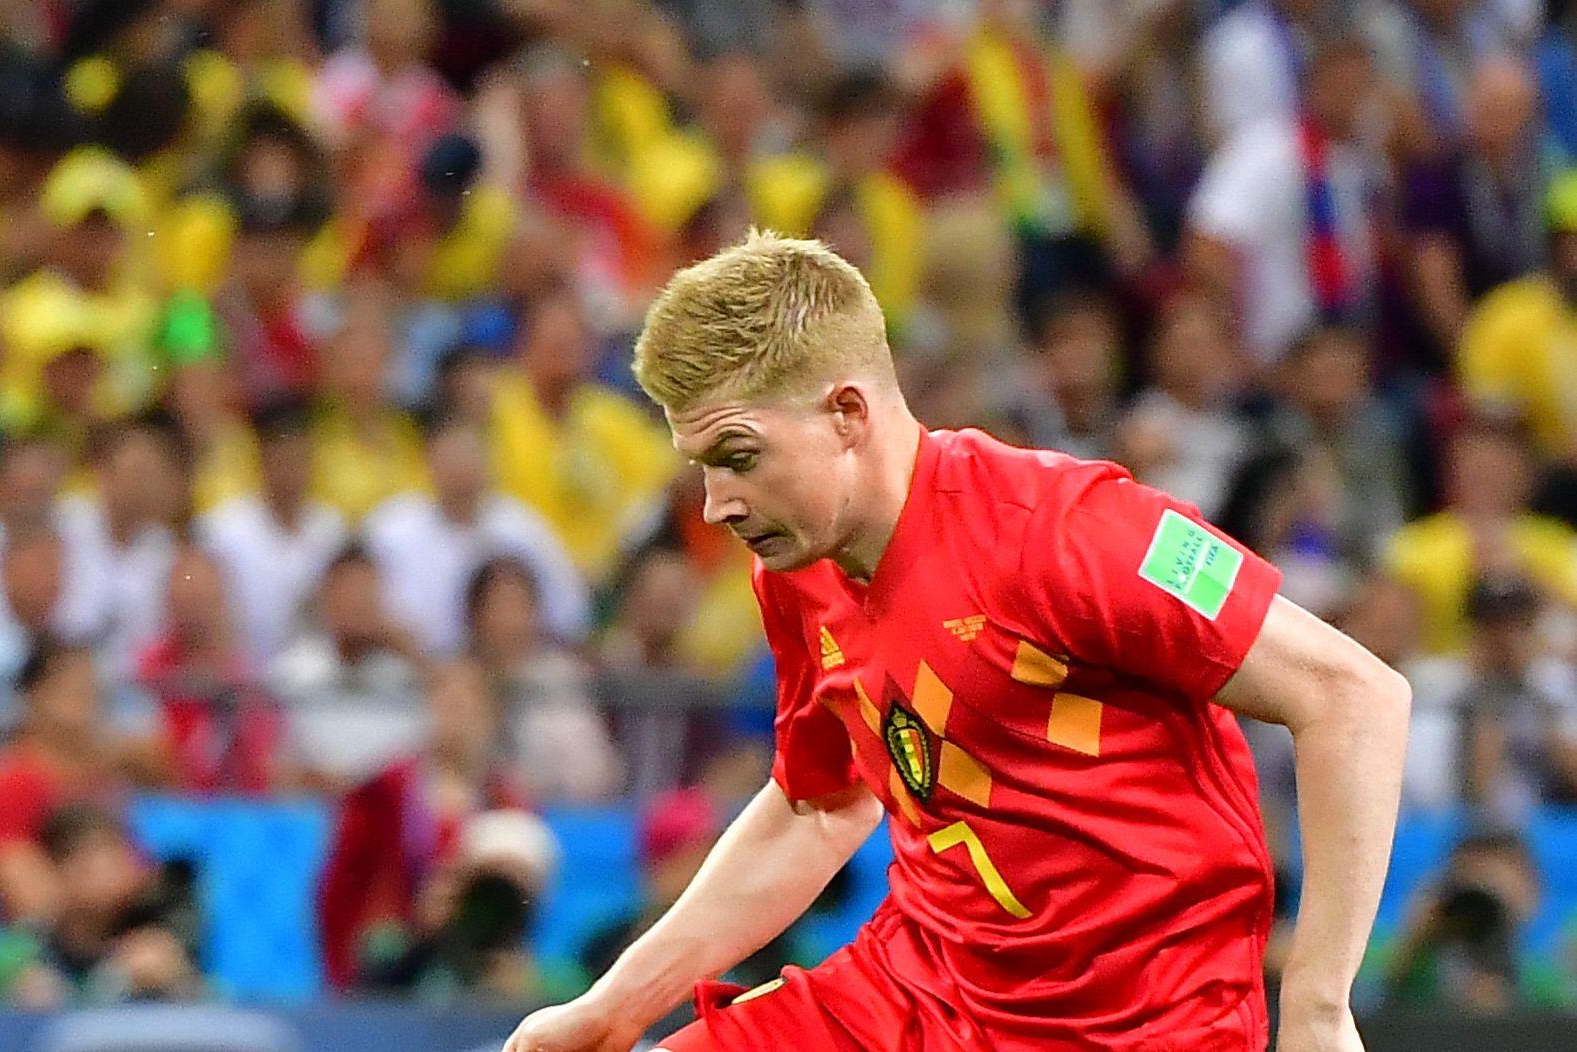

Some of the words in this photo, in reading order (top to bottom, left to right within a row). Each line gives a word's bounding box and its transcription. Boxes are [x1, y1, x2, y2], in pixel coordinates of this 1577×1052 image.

[1174, 535, 1204, 590] FOTBALL
[1205, 545, 1220, 567] FIFA
[926, 820, 1034, 919] 7
